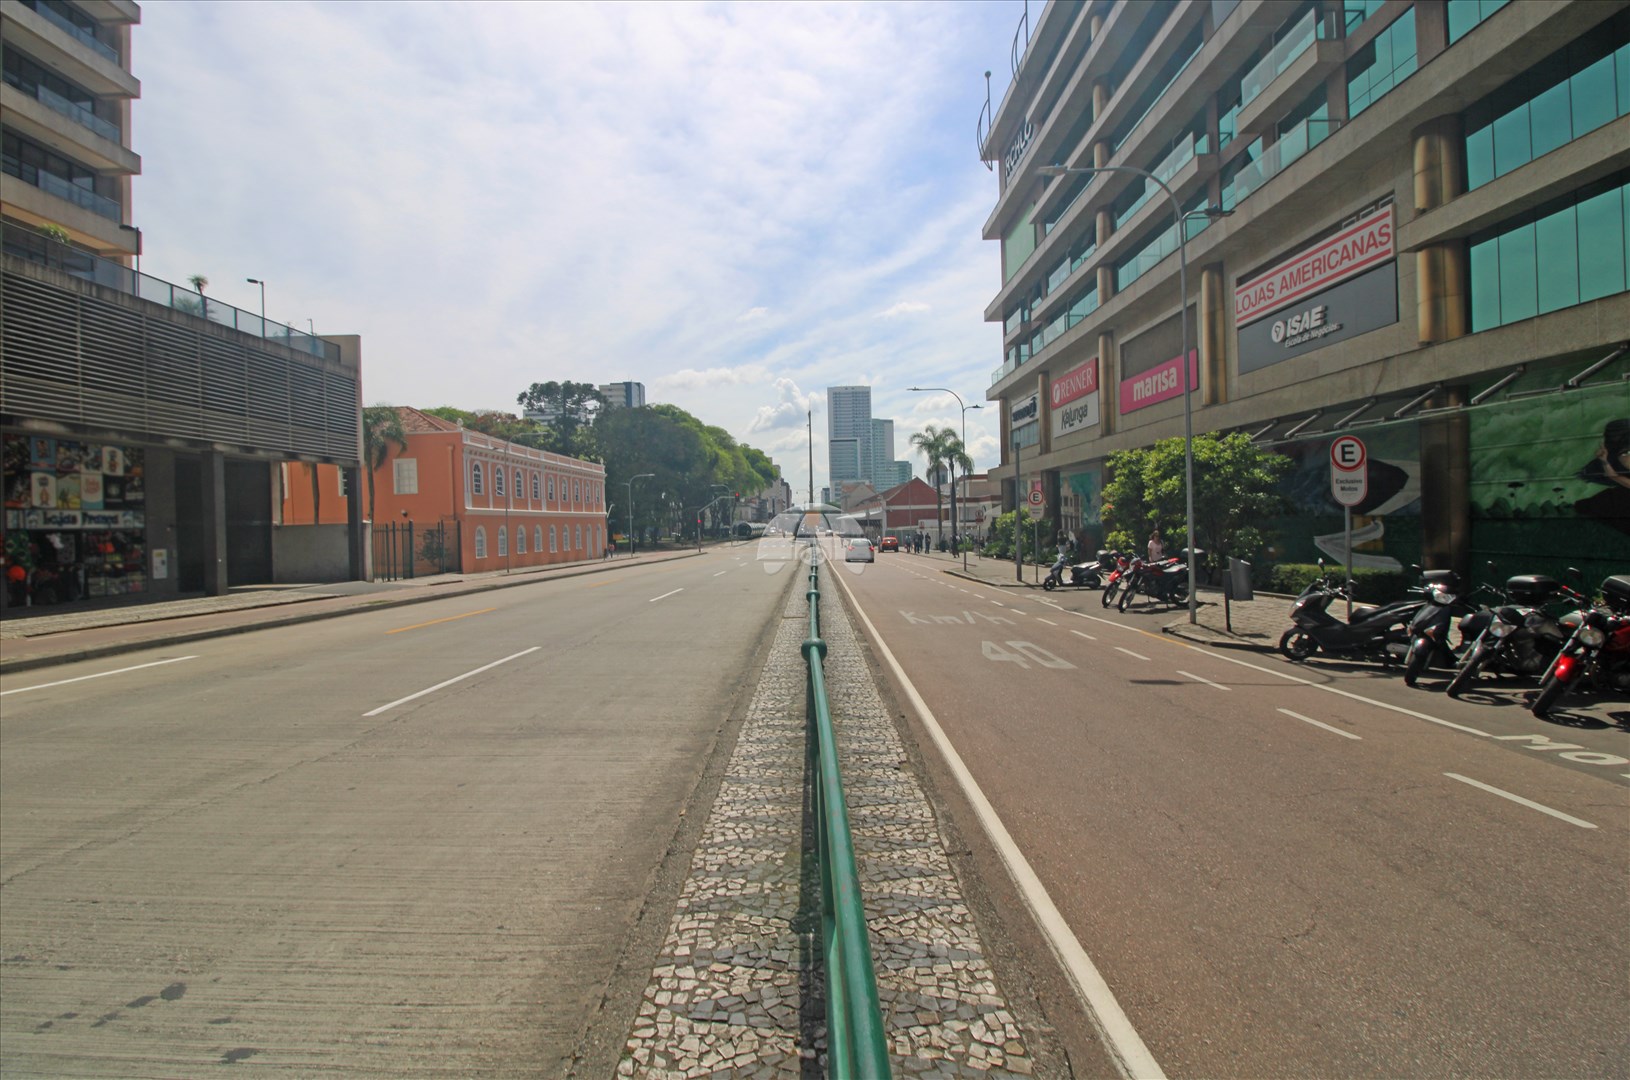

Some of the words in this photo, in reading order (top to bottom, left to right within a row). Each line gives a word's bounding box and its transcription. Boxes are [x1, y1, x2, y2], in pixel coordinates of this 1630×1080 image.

[1235, 281, 1275, 315] LOJAS
[1279, 223, 1392, 294] AMERICANAS
[1286, 305, 1325, 338] ISAE
[1285, 335, 1301, 348] Escola
[1060, 367, 1093, 399] RENNER
[1133, 367, 1177, 402] marisa
[1341, 444, 1355, 462] E
[1032, 492, 1040, 502] E
[981, 640, 1079, 669] 40
